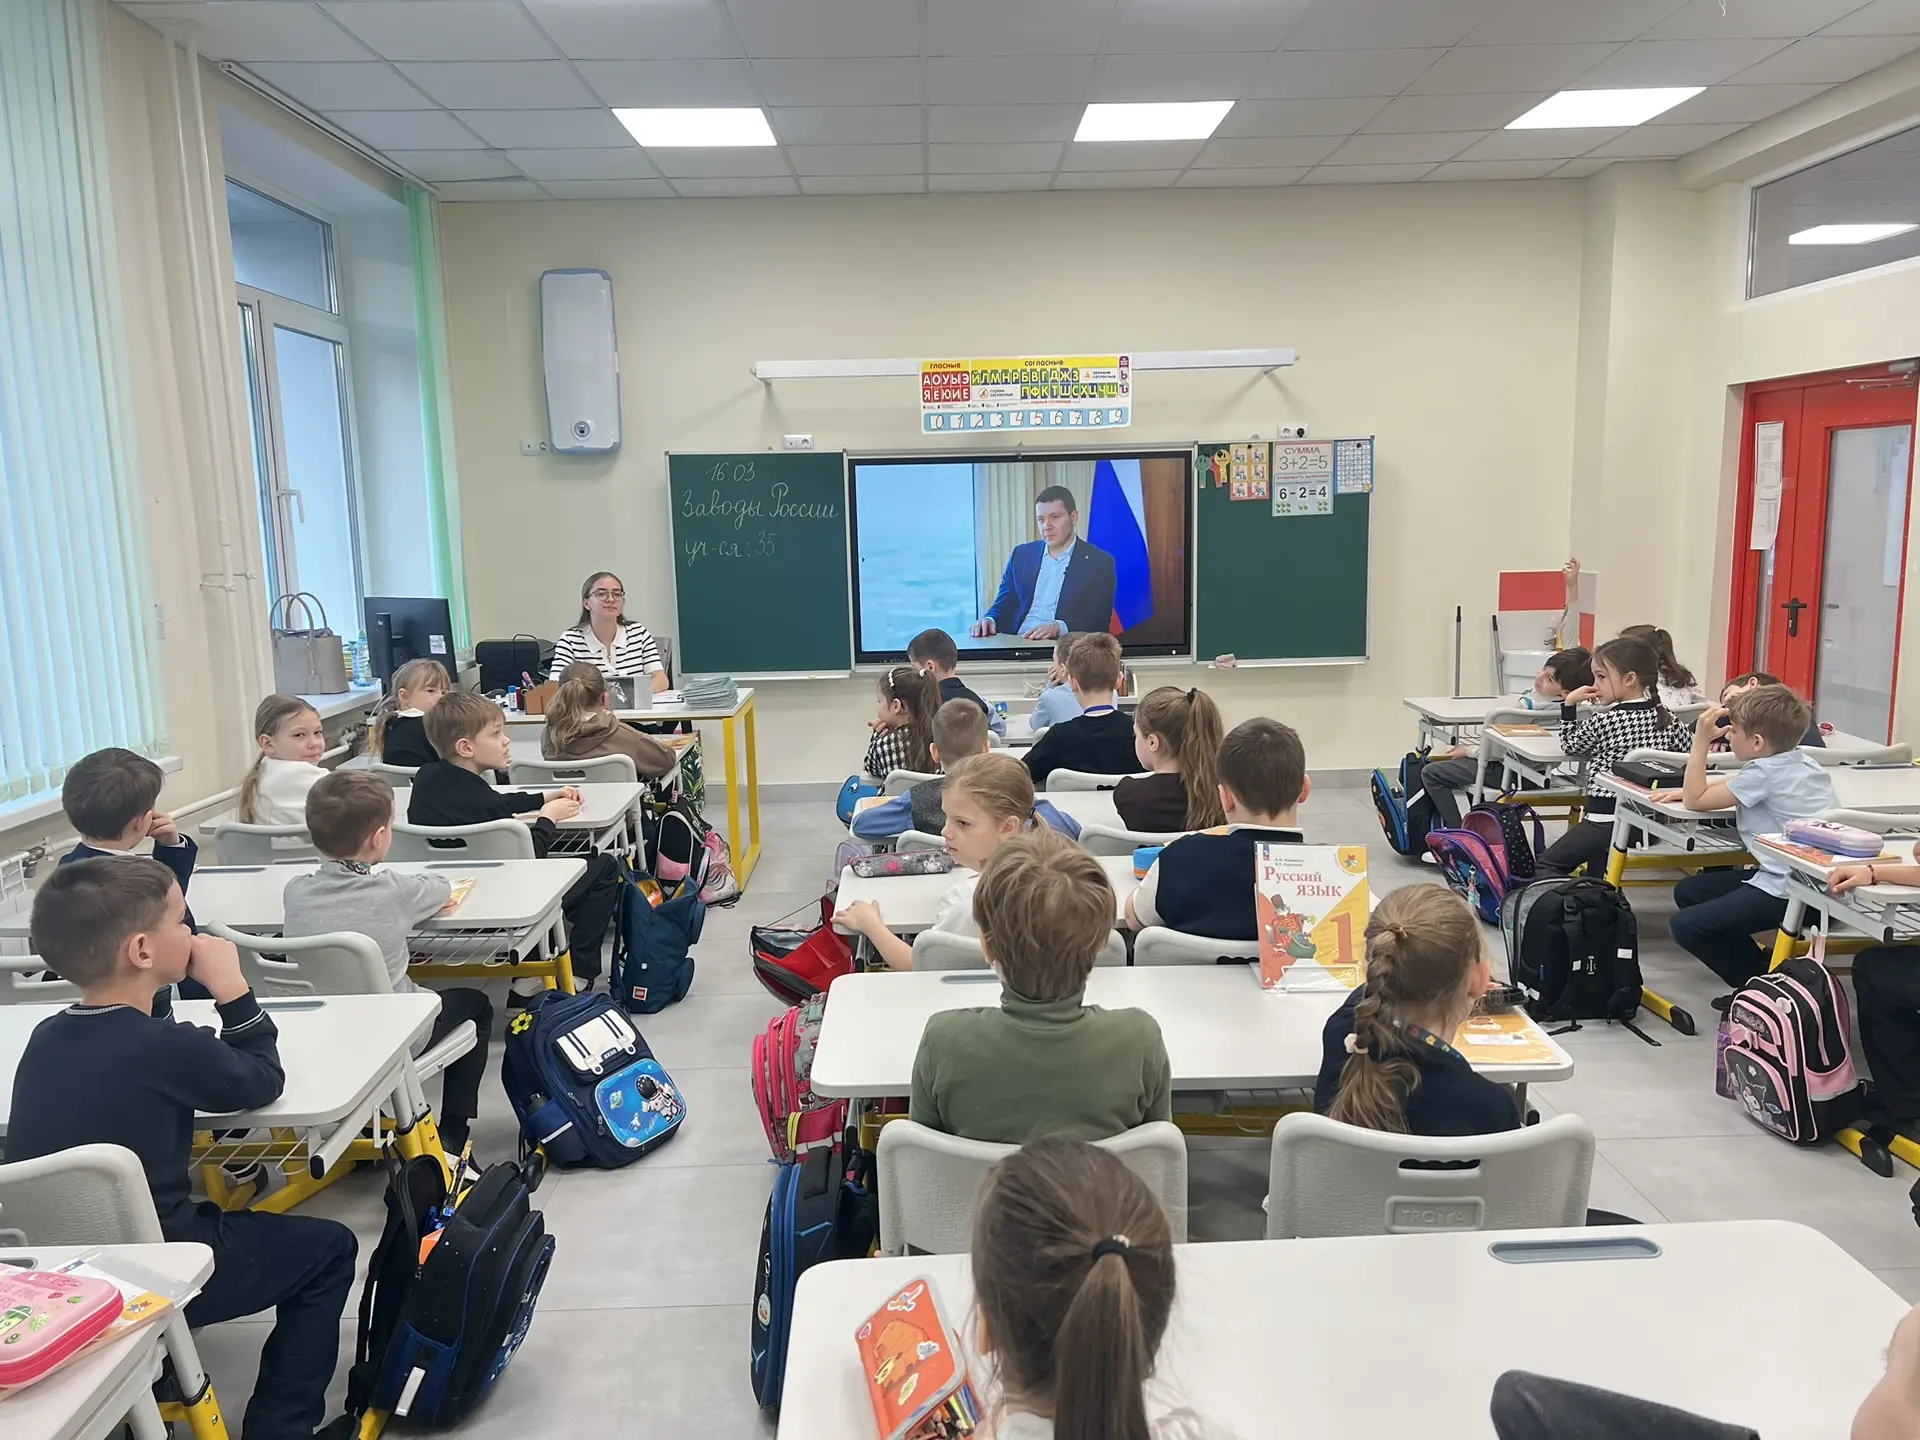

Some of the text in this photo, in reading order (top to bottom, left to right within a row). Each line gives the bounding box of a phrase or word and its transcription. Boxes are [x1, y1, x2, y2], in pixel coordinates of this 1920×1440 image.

[936, 408, 1123, 429] 0 1 2 3 4 5 6 7 8 9
[1284, 446, 1320, 455] СУММА
[704, 461, 755, 482] 16.03
[681, 482, 839, 530] Заводы России
[1264, 866, 1322, 884] Русский
[1329, 912, 1360, 964] 1
